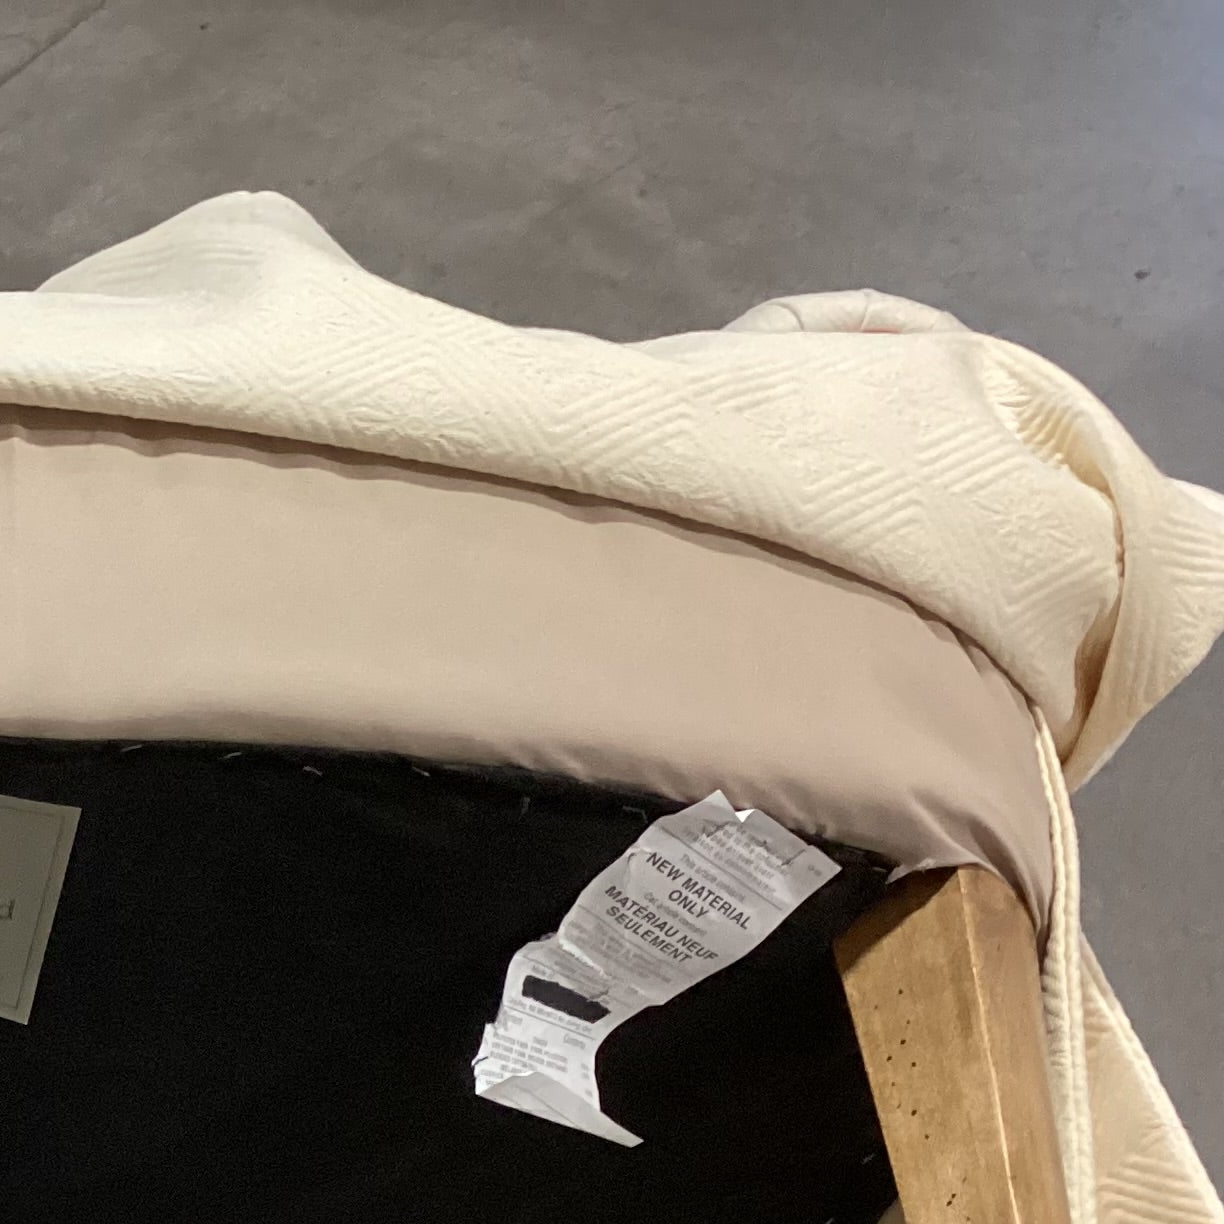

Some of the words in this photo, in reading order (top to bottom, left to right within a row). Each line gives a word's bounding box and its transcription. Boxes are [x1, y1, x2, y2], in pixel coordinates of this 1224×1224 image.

[605, 885, 679, 938] MATÉRIAU
[676, 934, 719, 961] NEUF
[646, 852, 684, 881] NEW
[681, 878, 751, 930] MATERIAL
[668, 890, 709, 919] ONLY
[606, 905, 692, 962] SEULEMENT
